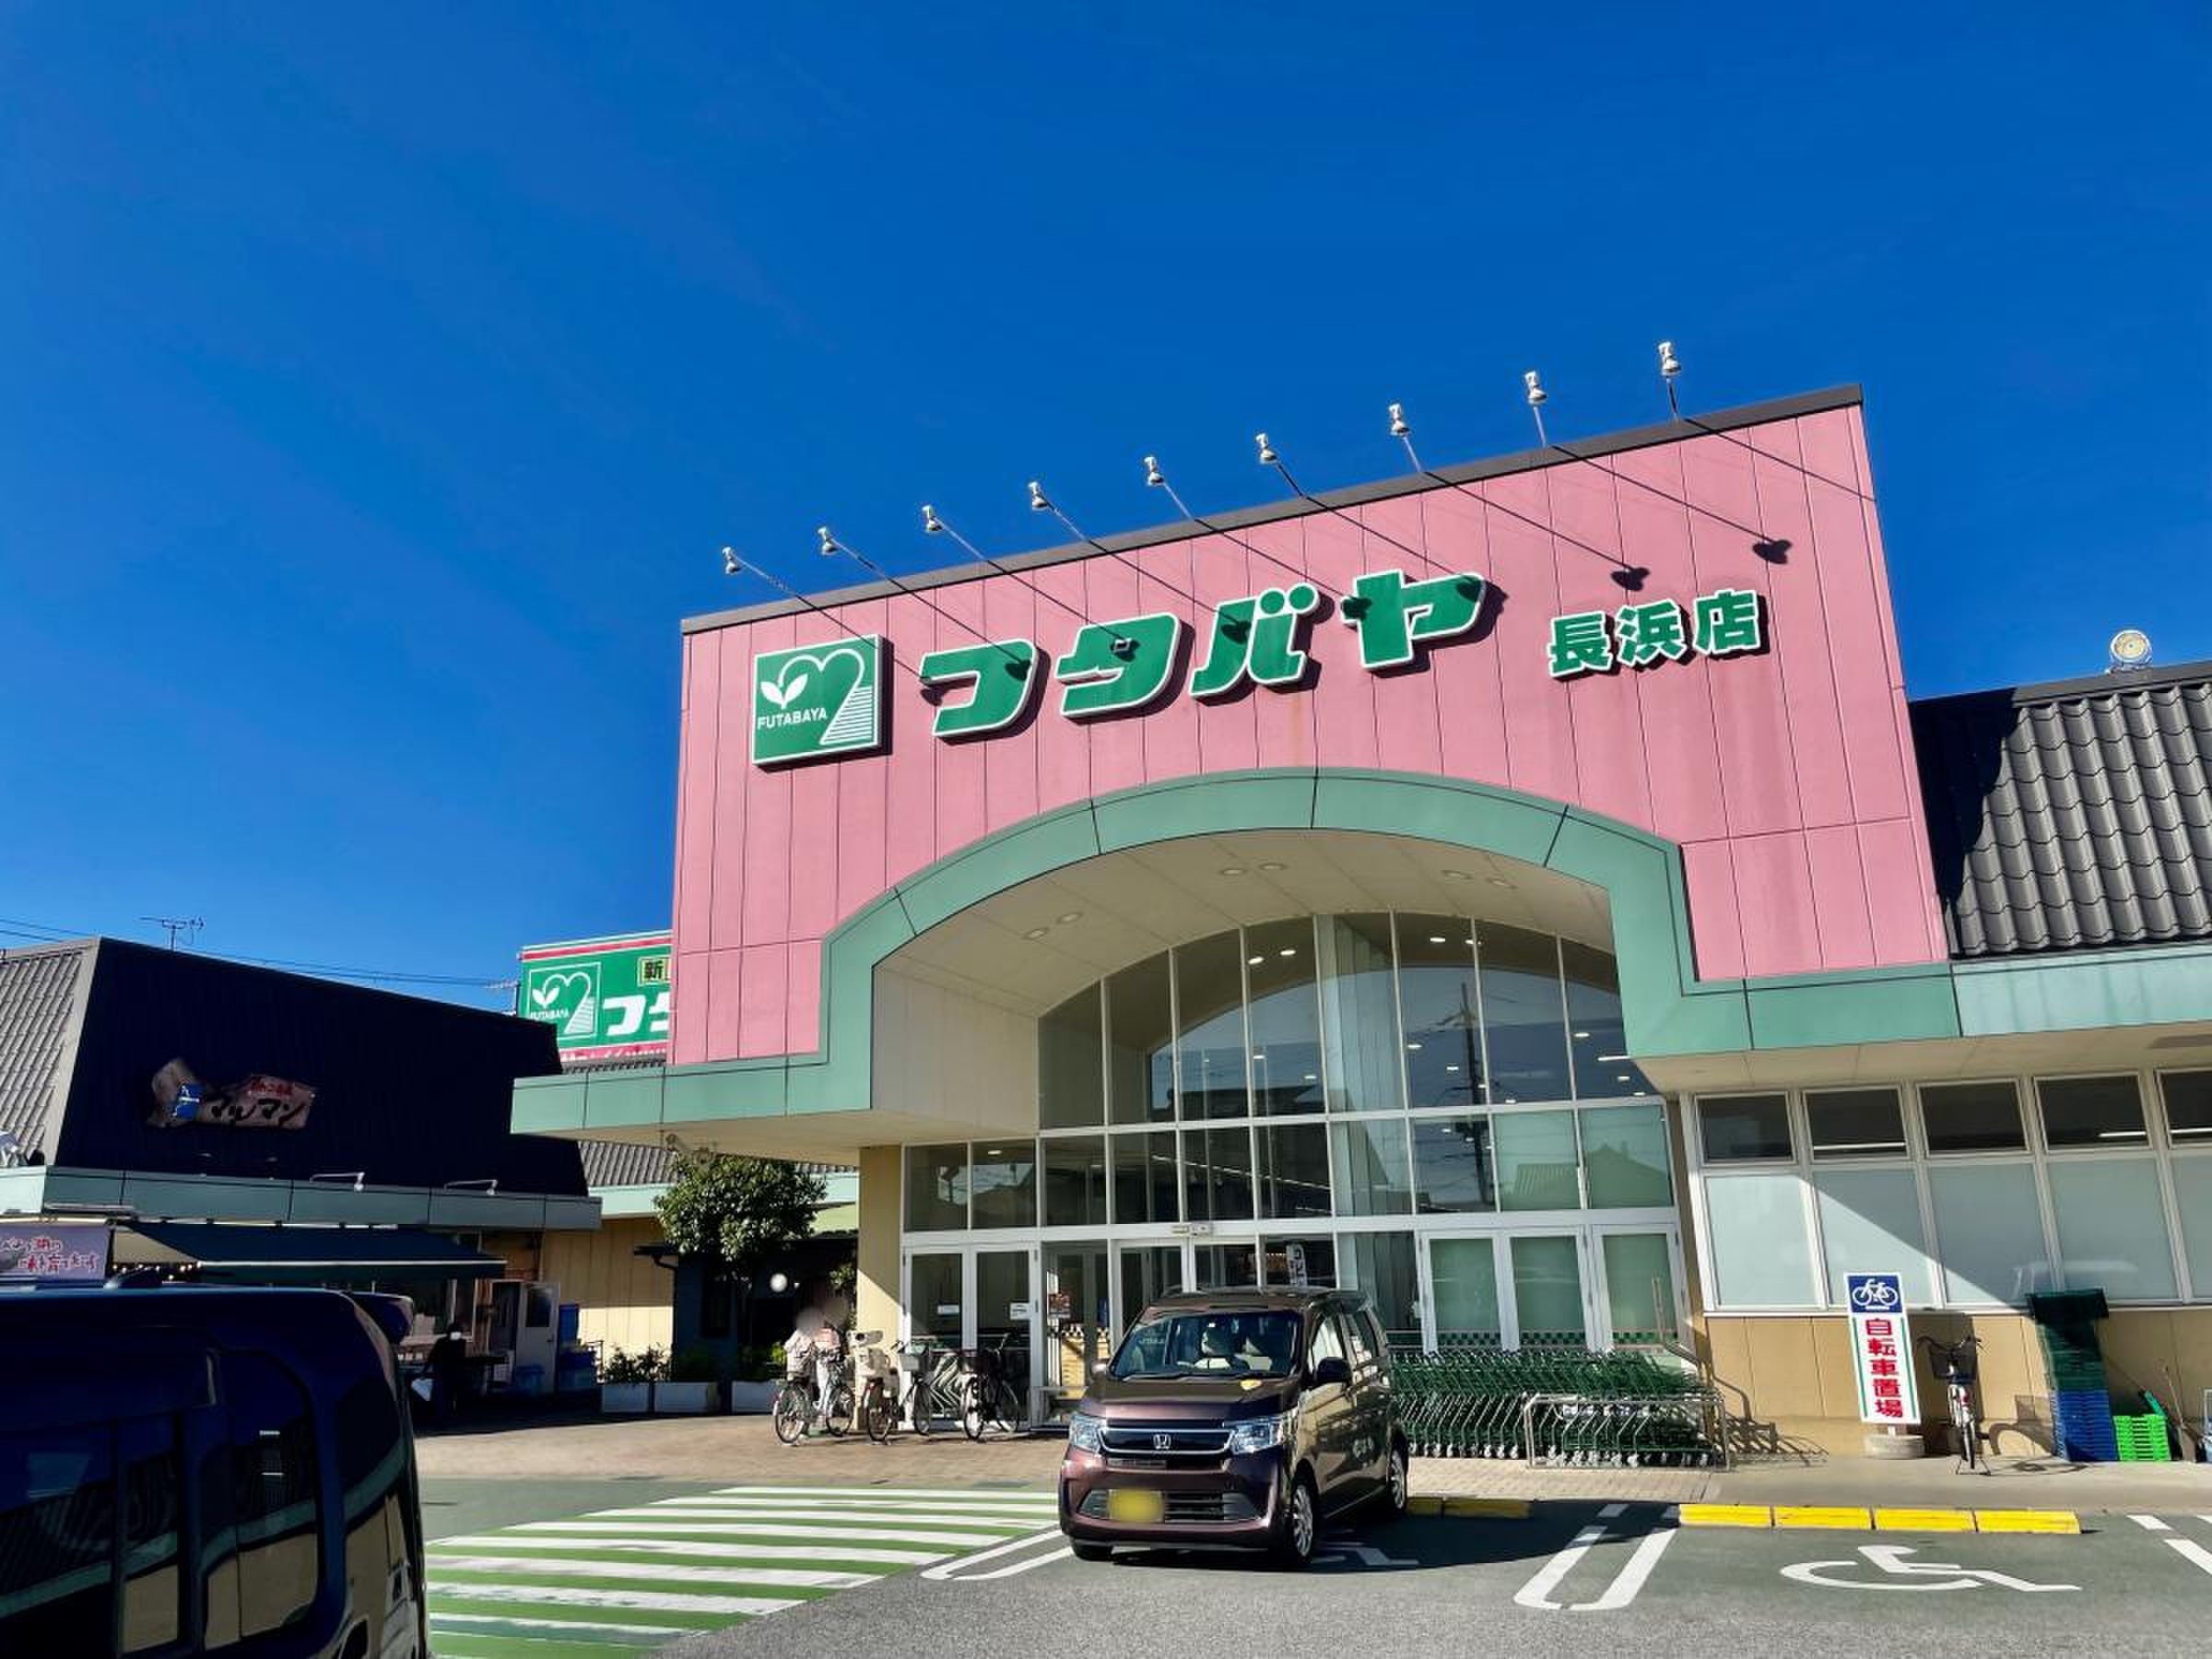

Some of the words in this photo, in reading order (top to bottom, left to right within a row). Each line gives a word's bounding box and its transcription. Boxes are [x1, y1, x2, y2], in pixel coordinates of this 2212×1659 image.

[920, 570, 1485, 735] フタバヤ
[1547, 588, 1760, 679] 長浜店
[757, 707, 829, 730] FUTABAYA
[1865, 1318, 1903, 1418] 自転車置場
